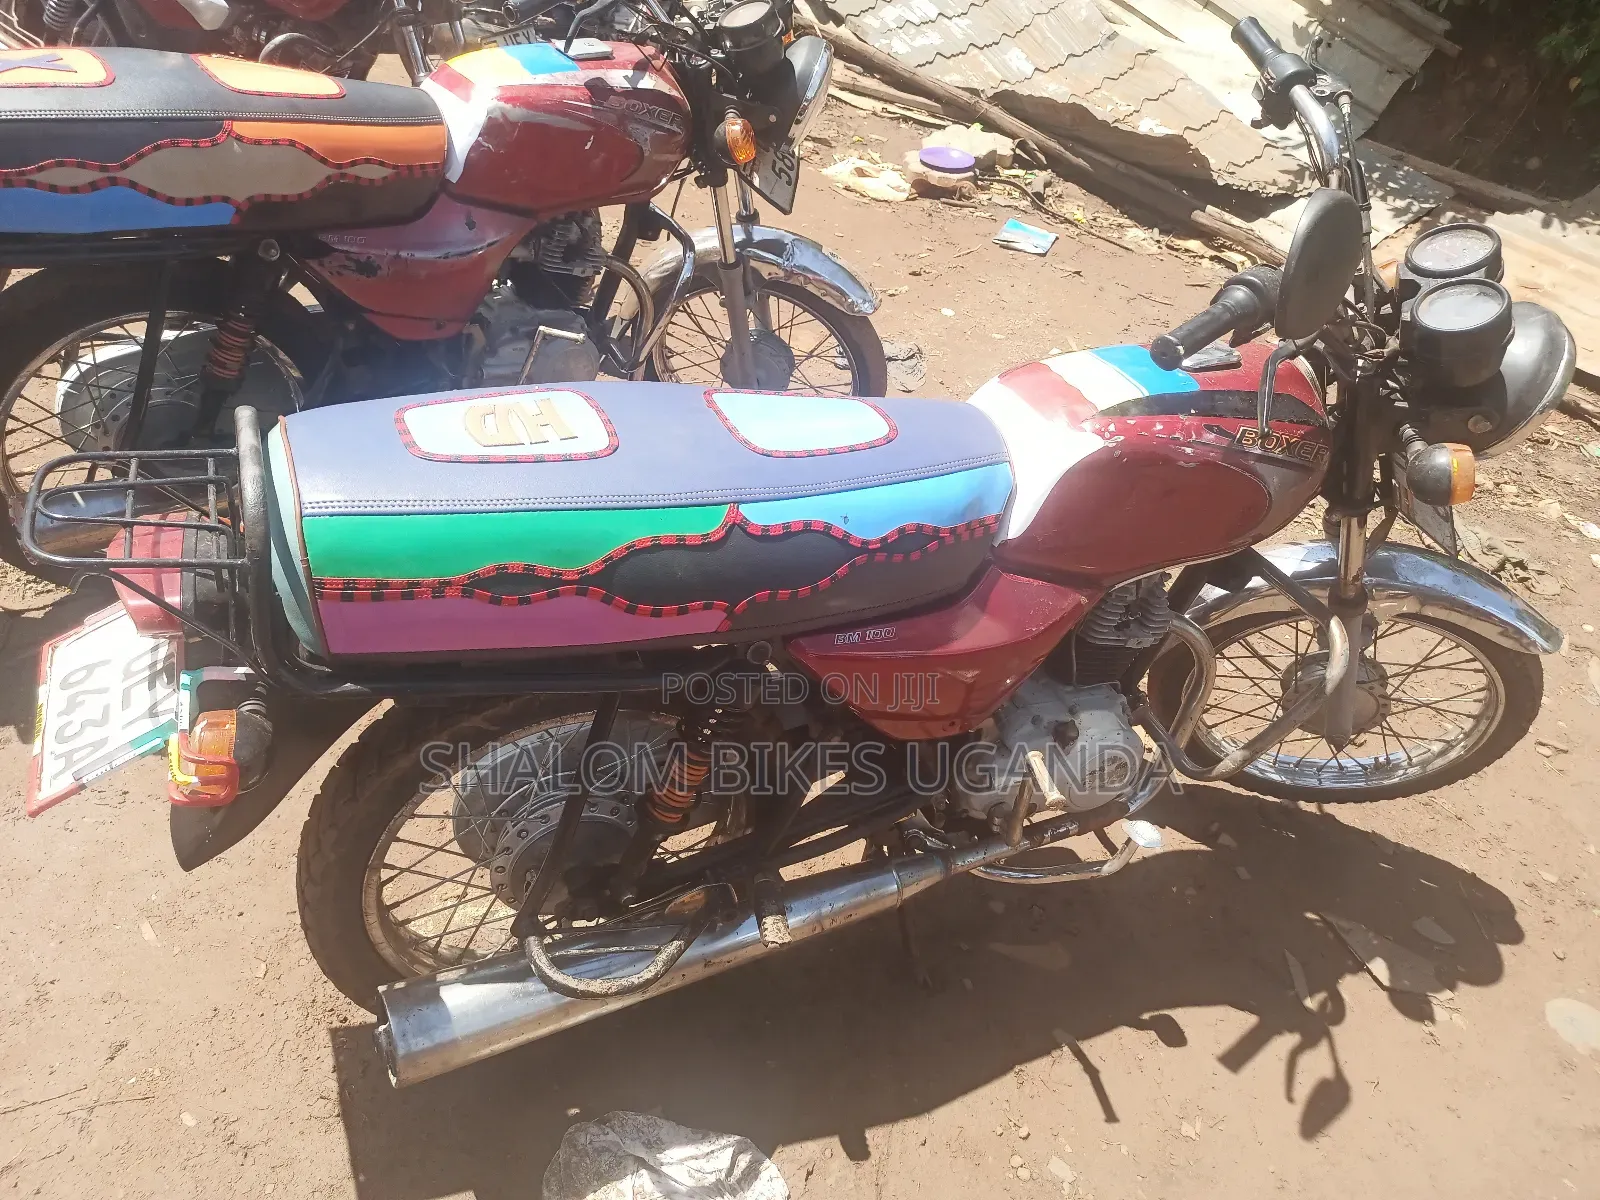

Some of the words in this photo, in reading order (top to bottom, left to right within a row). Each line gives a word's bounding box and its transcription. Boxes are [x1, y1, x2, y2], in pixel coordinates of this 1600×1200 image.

[1233, 425, 1330, 467] BOXER
[834, 631, 861, 645] BM
[865, 627, 896, 640] 100
[121, 640, 176, 730] UEY
[53, 659, 112, 781] 643A
